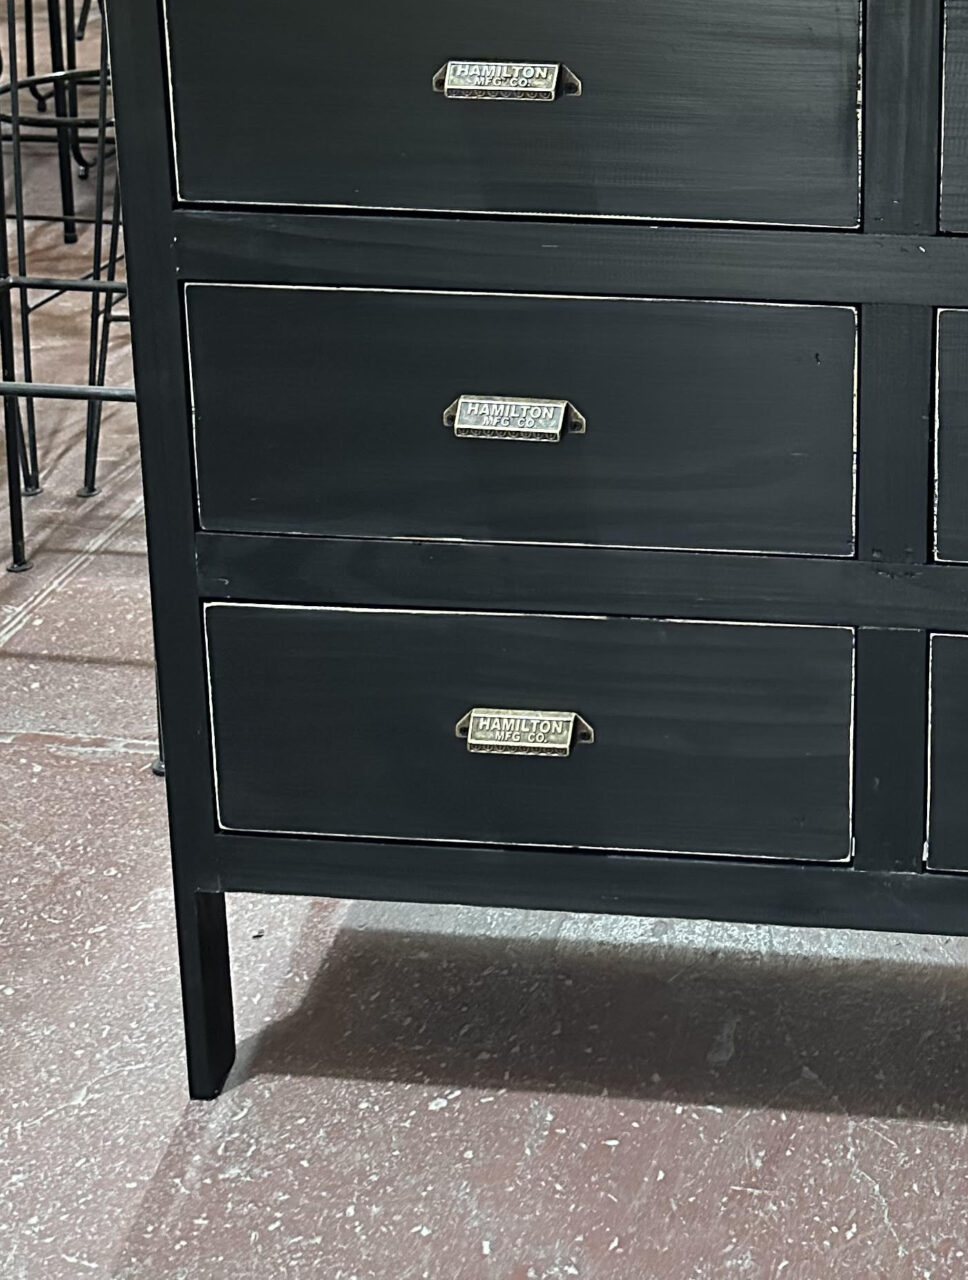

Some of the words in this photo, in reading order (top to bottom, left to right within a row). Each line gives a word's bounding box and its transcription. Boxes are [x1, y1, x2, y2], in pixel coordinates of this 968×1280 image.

[456, 65, 548, 78] HAMILTON
[473, 77, 502, 86] MFG
[467, 403, 555, 419] HAMILTON
[482, 416, 510, 427] MFG
[478, 717, 563, 734] HAMILTON
[494, 731, 521, 742] MFG
